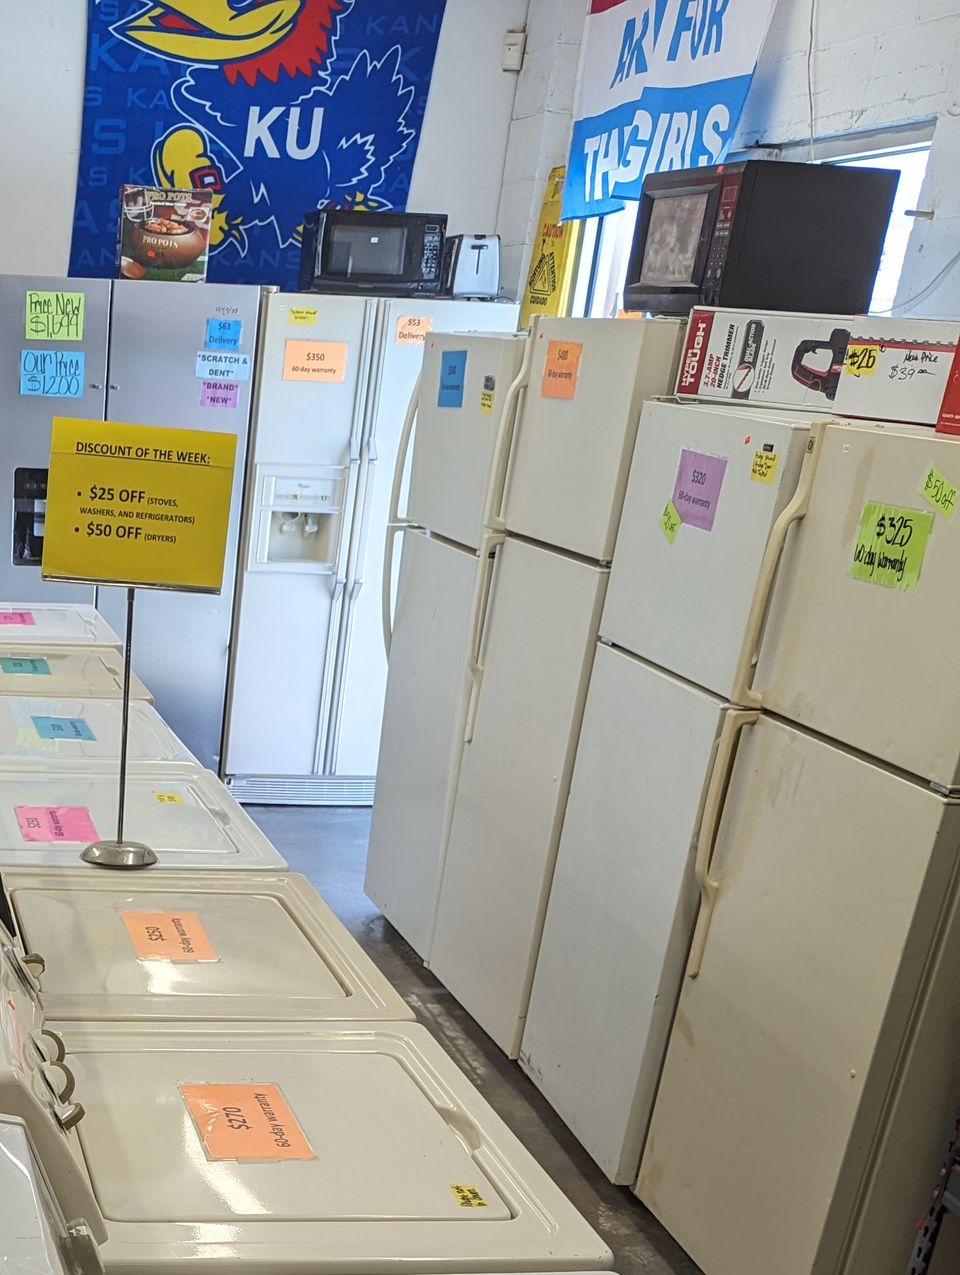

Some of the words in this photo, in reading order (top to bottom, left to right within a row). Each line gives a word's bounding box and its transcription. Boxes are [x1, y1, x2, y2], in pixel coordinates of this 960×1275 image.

[243, 106, 324, 160] KU
[143, 236, 157, 244] PRO
[158, 238, 178, 249] POTS
[29, 292, 53, 315] Price
[56, 293, 81, 315] New
[218, 322, 231, 331] $63
[408, 318, 421, 327] $53
[209, 336, 238, 347] Delivery
[398, 331, 426, 341] Delivery
[306, 353, 325, 362] $350
[686, 320, 707, 382] TOUGH
[717, 363, 727, 388] HEDGE
[723, 323, 735, 361] TRIMMER
[921, 352, 939, 363] Price
[23, 352, 52, 374] Our
[55, 352, 81, 377] Price
[311, 367, 336, 376] warranty
[704, 353, 714, 388] 3.7-AMP
[710, 356, 721, 388] 20-INCH
[76, 442, 133, 457] DISCOUNT
[135, 447, 149, 458] OF
[153, 449, 173, 461] THE
[176, 451, 210, 464] WEEK:
[691, 469, 706, 485] $320
[90, 485, 114, 501] $25
[118, 489, 145, 503] OFF
[147, 497, 178, 508] (STOVES,
[80, 507, 116, 518] WASHERS,
[118, 510, 134, 519] AND
[135, 512, 195, 525] REFRIGERATORS)
[87, 521, 111, 538] $50
[116, 525, 142, 539] OFF
[144, 533, 176, 544] (DRYERS)
[876, 514, 913, 547] $325
[145, 926, 167, 942] $250
[171, 917, 187, 937] warranty
[222, 1106, 252, 1130] $270
[253, 1092, 277, 1124] warranty
[270, 1124, 291, 1148] 60-day
